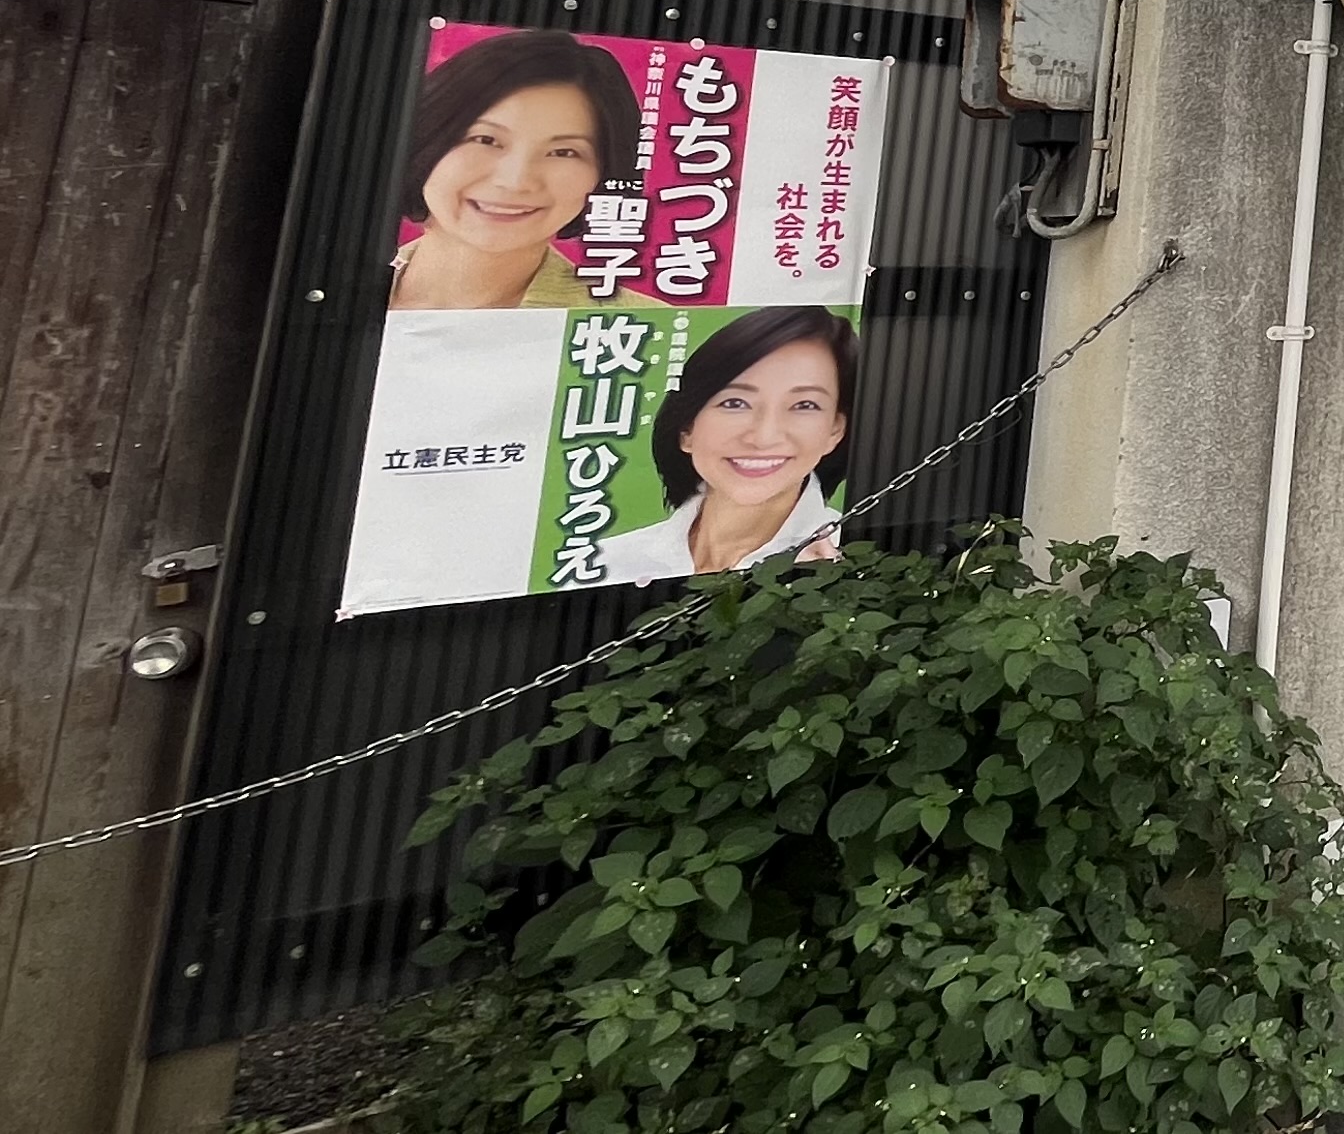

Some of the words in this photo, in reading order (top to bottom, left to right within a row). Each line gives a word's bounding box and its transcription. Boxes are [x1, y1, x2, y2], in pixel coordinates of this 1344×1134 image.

[604, 179, 644, 191] せいこ
[655, 56, 738, 296] もちづき
[815, 75, 863, 269] 笑顔が生まれる
[577, 194, 649, 298] 聖子
[774, 183, 809, 280] 社会を。
[382, 442, 526, 470] 立憲民主党
[551, 316, 649, 584] 牧山ひろえ
